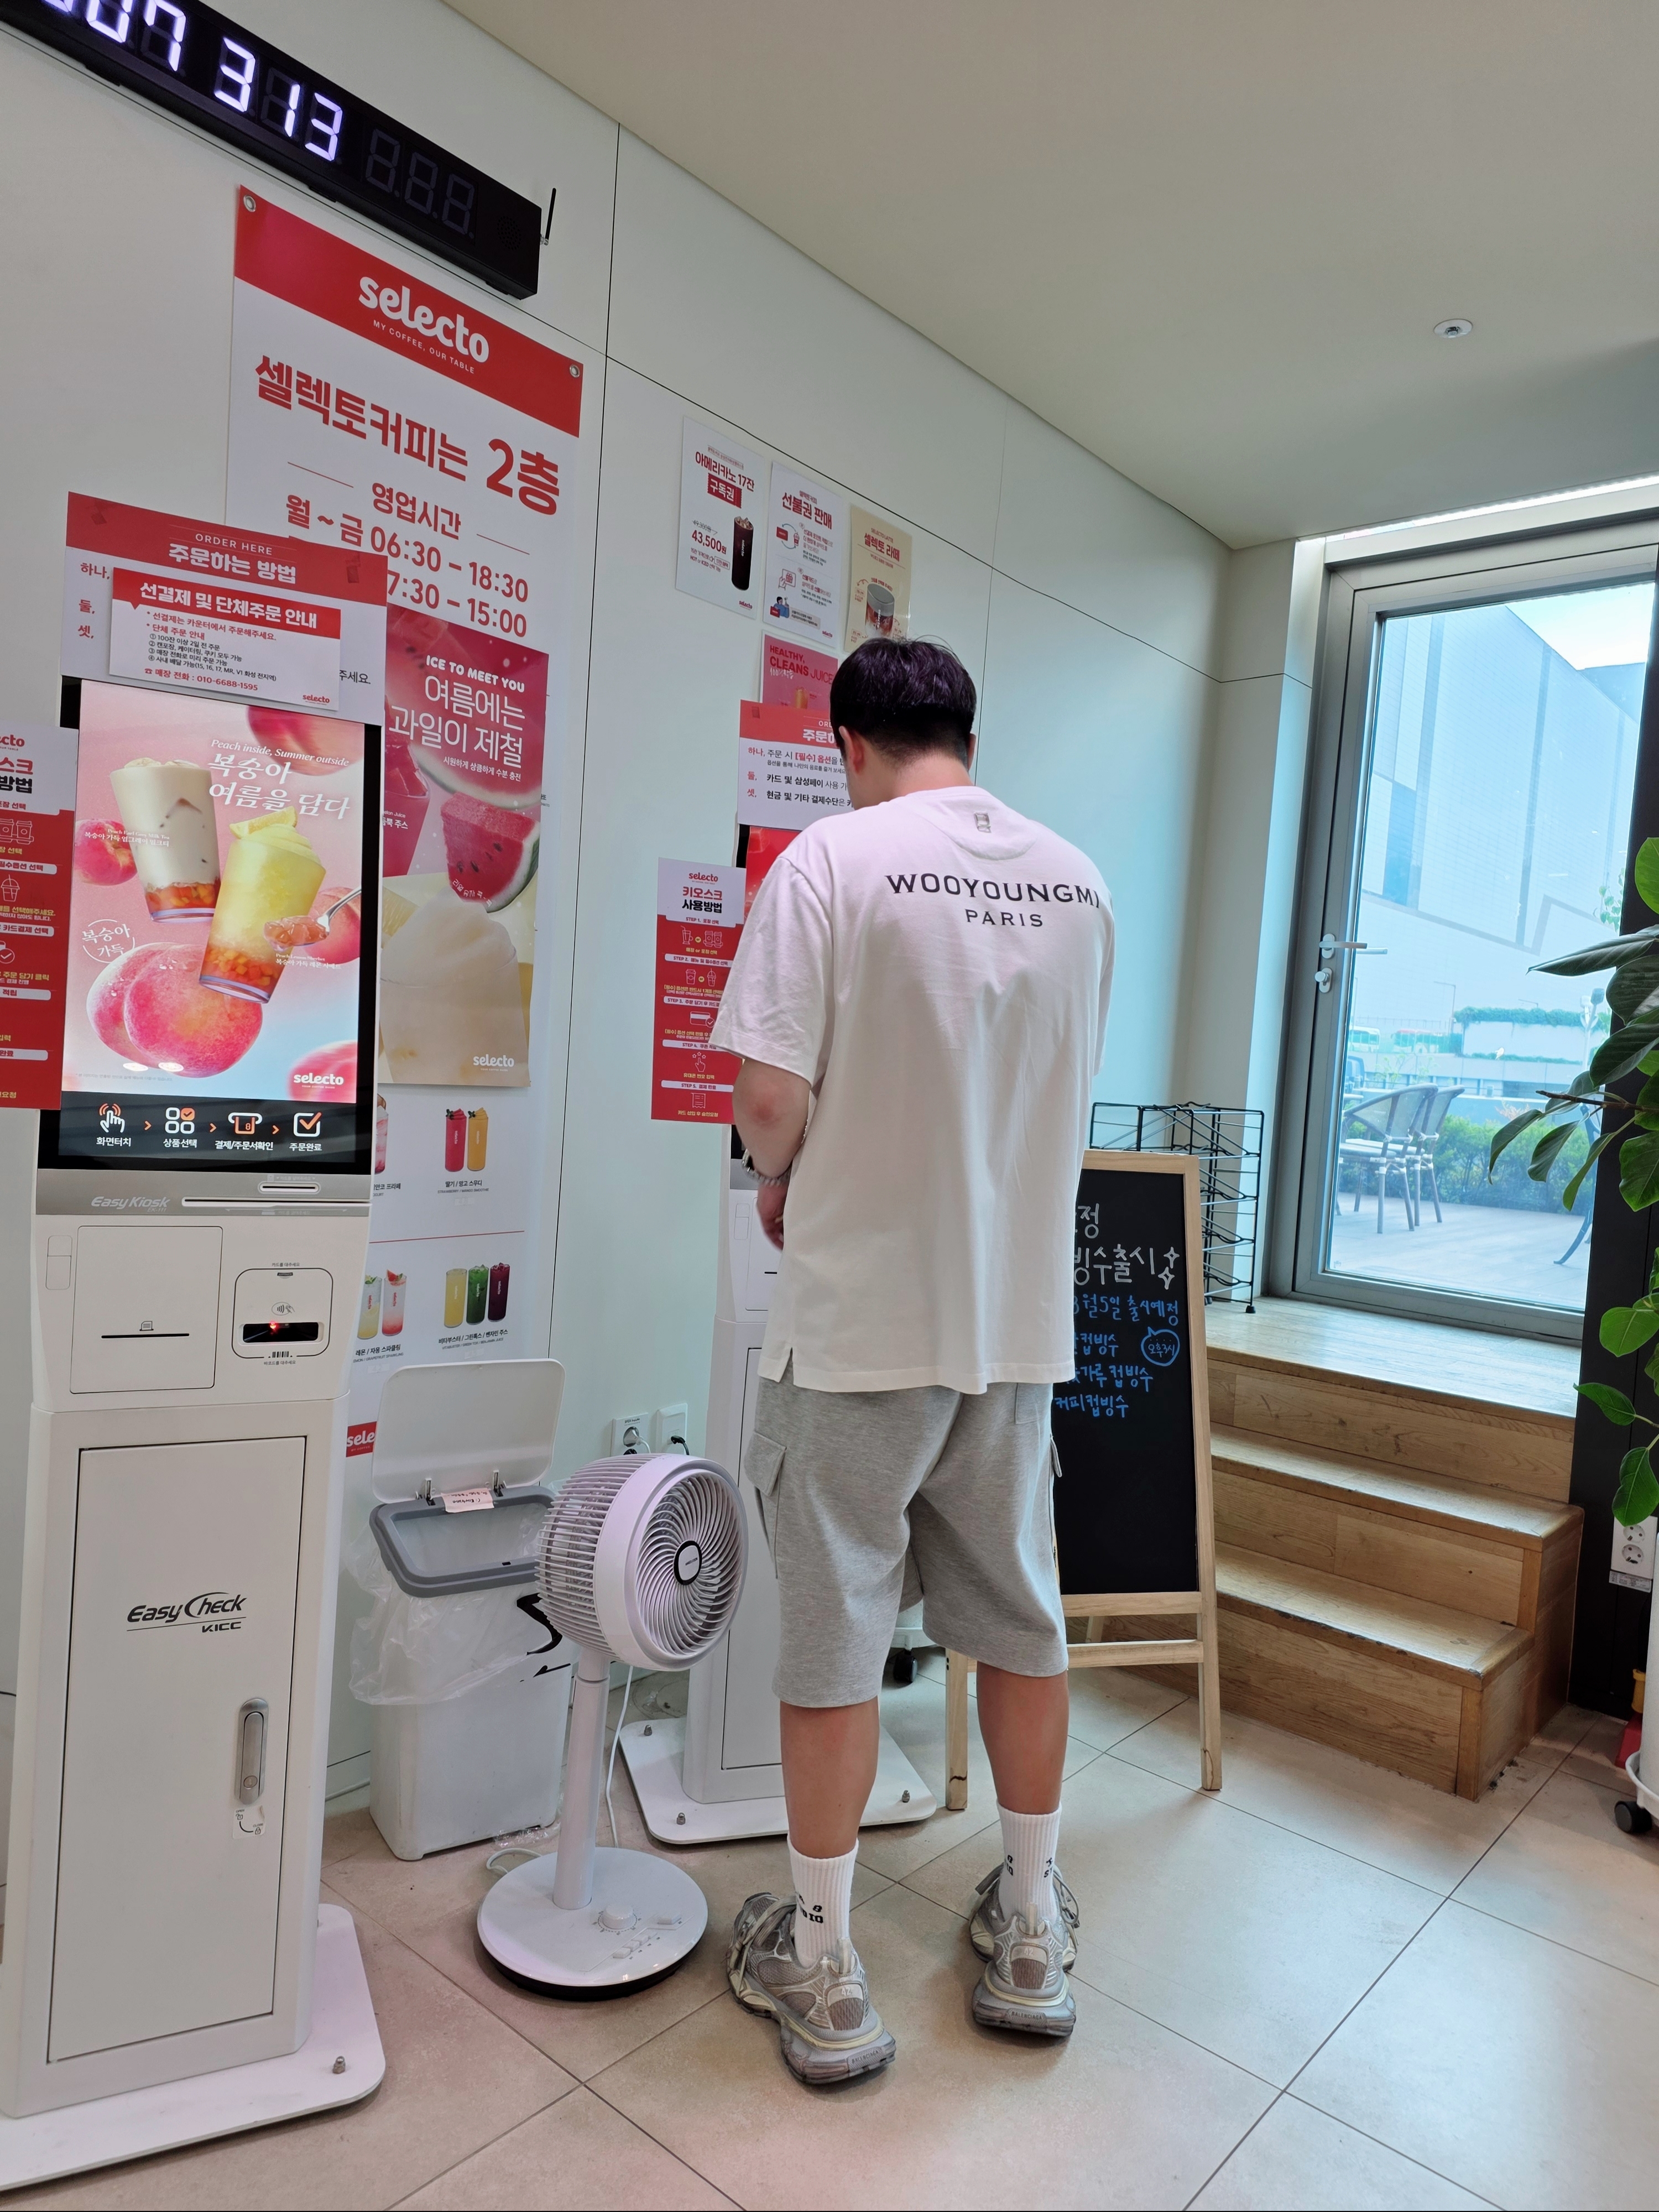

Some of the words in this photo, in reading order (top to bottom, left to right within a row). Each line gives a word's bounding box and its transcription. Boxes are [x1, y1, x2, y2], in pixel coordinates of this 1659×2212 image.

[358, 276, 489, 363] selecto
[373, 319, 386, 331] MY
[389, 327, 426, 351] COFFEE,
[429, 347, 447, 361] OUR
[450, 357, 475, 374] TABLE
[255, 354, 468, 482] 셀렉토커피는
[487, 439, 560, 515] 2층
[696, 451, 736, 483] 아메리카노
[738, 474, 754, 492] 17잔
[711, 478, 734, 502] 구독권
[372, 482, 461, 540] 영업시간
[782, 492, 812, 520] 선물권
[814, 507, 832, 530] 판매
[195, 533, 238, 550] ORDER
[242, 541, 273, 555] HERE
[286, 494, 310, 529] 월
[340, 513, 363, 547] 금
[371, 526, 441, 572] 06:30
[469, 561, 528, 603] 18:30
[692, 530, 727, 555] 43,500원
[864, 533, 885, 554] 셀렉토
[886, 544, 900, 562] 라떼
[80, 562, 110, 580] 하나,
[169, 542, 250, 576] 주문하는
[257, 560, 296, 584] 방법
[79, 599, 95, 614] 둘,
[140, 582, 191, 607] 선결제
[196, 593, 212, 610] 및
[216, 596, 281, 623] 단체주문
[285, 609, 317, 629] 안내
[153, 612, 185, 625] 선결제는
[187, 619, 226, 632] 카운터에서
[228, 625, 276, 640] 주문해주세요.
[467, 597, 526, 638] 15:00
[78, 624, 94, 639] 셋,
[153, 624, 168, 634] 단체
[171, 627, 186, 637] 주문
[189, 631, 205, 640] 안내
[158, 635, 175, 643] 100잔
[170, 651, 187, 659] 전화로
[770, 645, 805, 664] HEALTHY,
[155, 669, 171, 678] 매장
[174, 671, 190, 681] 전화
[197, 675, 258, 691] 010-6688-1595
[426, 654, 446, 670] ICE
[449, 661, 465, 676] TO
[468, 667, 498, 686] MEET
[502, 677, 525, 693] YOU
[770, 656, 809, 676] CLEANS
[810, 669, 833, 685] JUICE
[302, 694, 330, 703] selecto
[425, 675, 525, 731] 여름에는
[0, 734, 25, 747] cto
[389, 705, 466, 754] 과일이
[474, 724, 523, 769] 제철
[211, 739, 241, 751] Peach
[242, 744, 273, 757] inside,
[274, 749, 315, 761] Summer
[316, 755, 349, 767] outside
[748, 747, 765, 757] 하나,
[767, 749, 782, 758] 주문
[785, 751, 793, 759] 시
[795, 752, 816, 762] [필수]
[817, 755, 838, 765] 옵션을
[207, 753, 293, 785] 복숭아
[443, 755, 469, 770] 시원하게
[469, 761, 494, 776] 상큼하게
[495, 768, 508, 779] 수분
[747, 771, 757, 781] 둘,
[766, 774, 781, 783] 카드
[784, 776, 792, 784] 및
[795, 777, 823, 788] 삼성페이
[825, 780, 839, 790] 사용
[209, 782, 291, 812] 여름을
[299, 794, 351, 820] 담다
[747, 789, 757, 797] 셋,
[766, 790, 781, 800] 현금
[784, 792, 792, 801] 및
[794, 794, 809, 802] 기타
[811, 795, 845, 807] 결제수단은
[394, 820, 408, 829] 주스
[688, 872, 718, 882] selecto
[682, 886, 722, 901] 키오스크
[885, 873, 1100, 908] WOOYOUNGMI
[682, 899, 722, 914] 사용방법
[964, 909, 1044, 927] PARIS
[82, 922, 131, 943] 복숭아
[97, 943, 126, 958] 가득
[473, 1054, 514, 1067] selecto
[294, 1073, 344, 1085] selecto
[96, 1136, 132, 1147] 화면터치
[163, 1138, 197, 1149] 상품선택
[215, 1140, 274, 1151] 결제/주문서확인
[289, 1142, 322, 1152] 주문완료
[1076, 1203, 1099, 1239] 정
[1128, 1295, 1178, 1326] 출시예정
[370, 1347, 380, 1355] 자몽
[380, 1344, 401, 1353] 스파클링
[1074, 1333, 1119, 1357] 컵빙수
[1109, 1364, 1153, 1392] 컵빙수
[202, 1621, 242, 1632] KICC
[841, 1986, 852, 1996] 42
